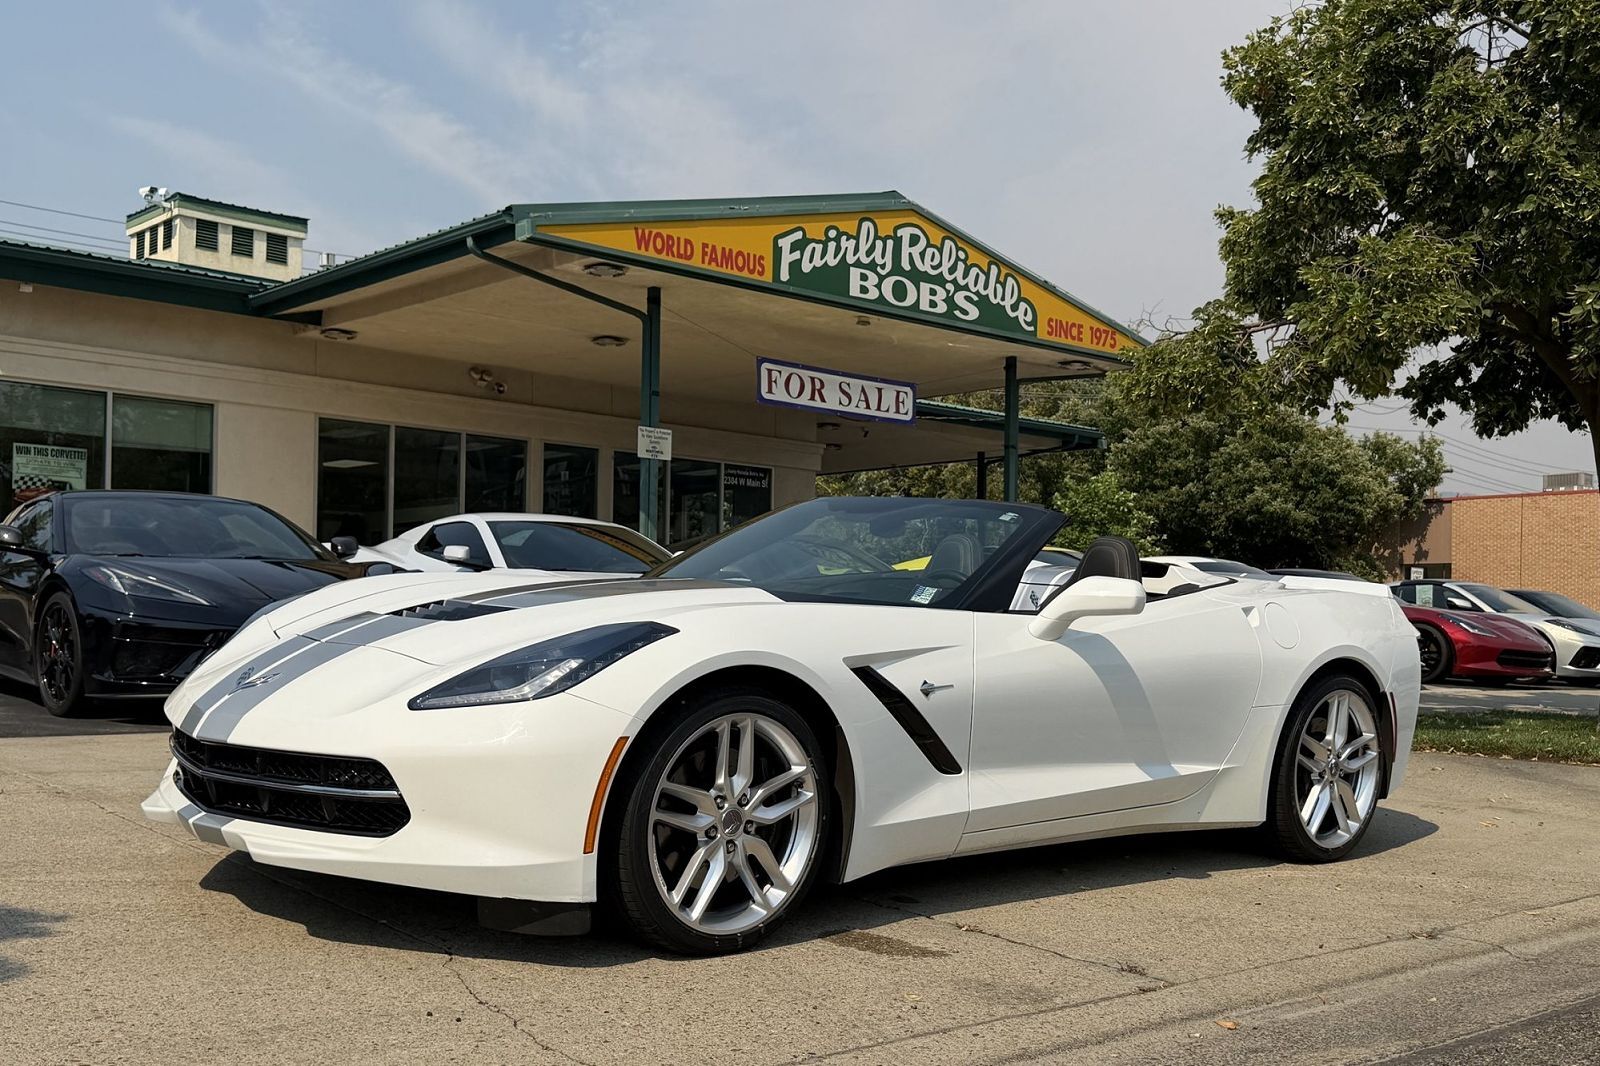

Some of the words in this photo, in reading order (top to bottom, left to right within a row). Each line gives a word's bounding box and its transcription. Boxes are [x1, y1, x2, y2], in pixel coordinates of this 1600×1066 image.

[633, 226, 695, 262] WORLD
[701, 242, 766, 277] FAMOUS
[777, 220, 894, 282] Fairly
[896, 226, 1035, 331] Reliable
[849, 267, 980, 321] BOB'S
[1046, 317, 1083, 342] SINCE
[1089, 326, 1117, 349] 1975
[765, 368, 827, 403] FOR
[838, 381, 910, 416] SALE
[15, 445, 32, 456] WIN
[33, 446, 49, 457] THIS
[50, 448, 87, 460] CORVETTE!
[739, 477, 746, 487] W
[746, 478, 761, 488] Main
